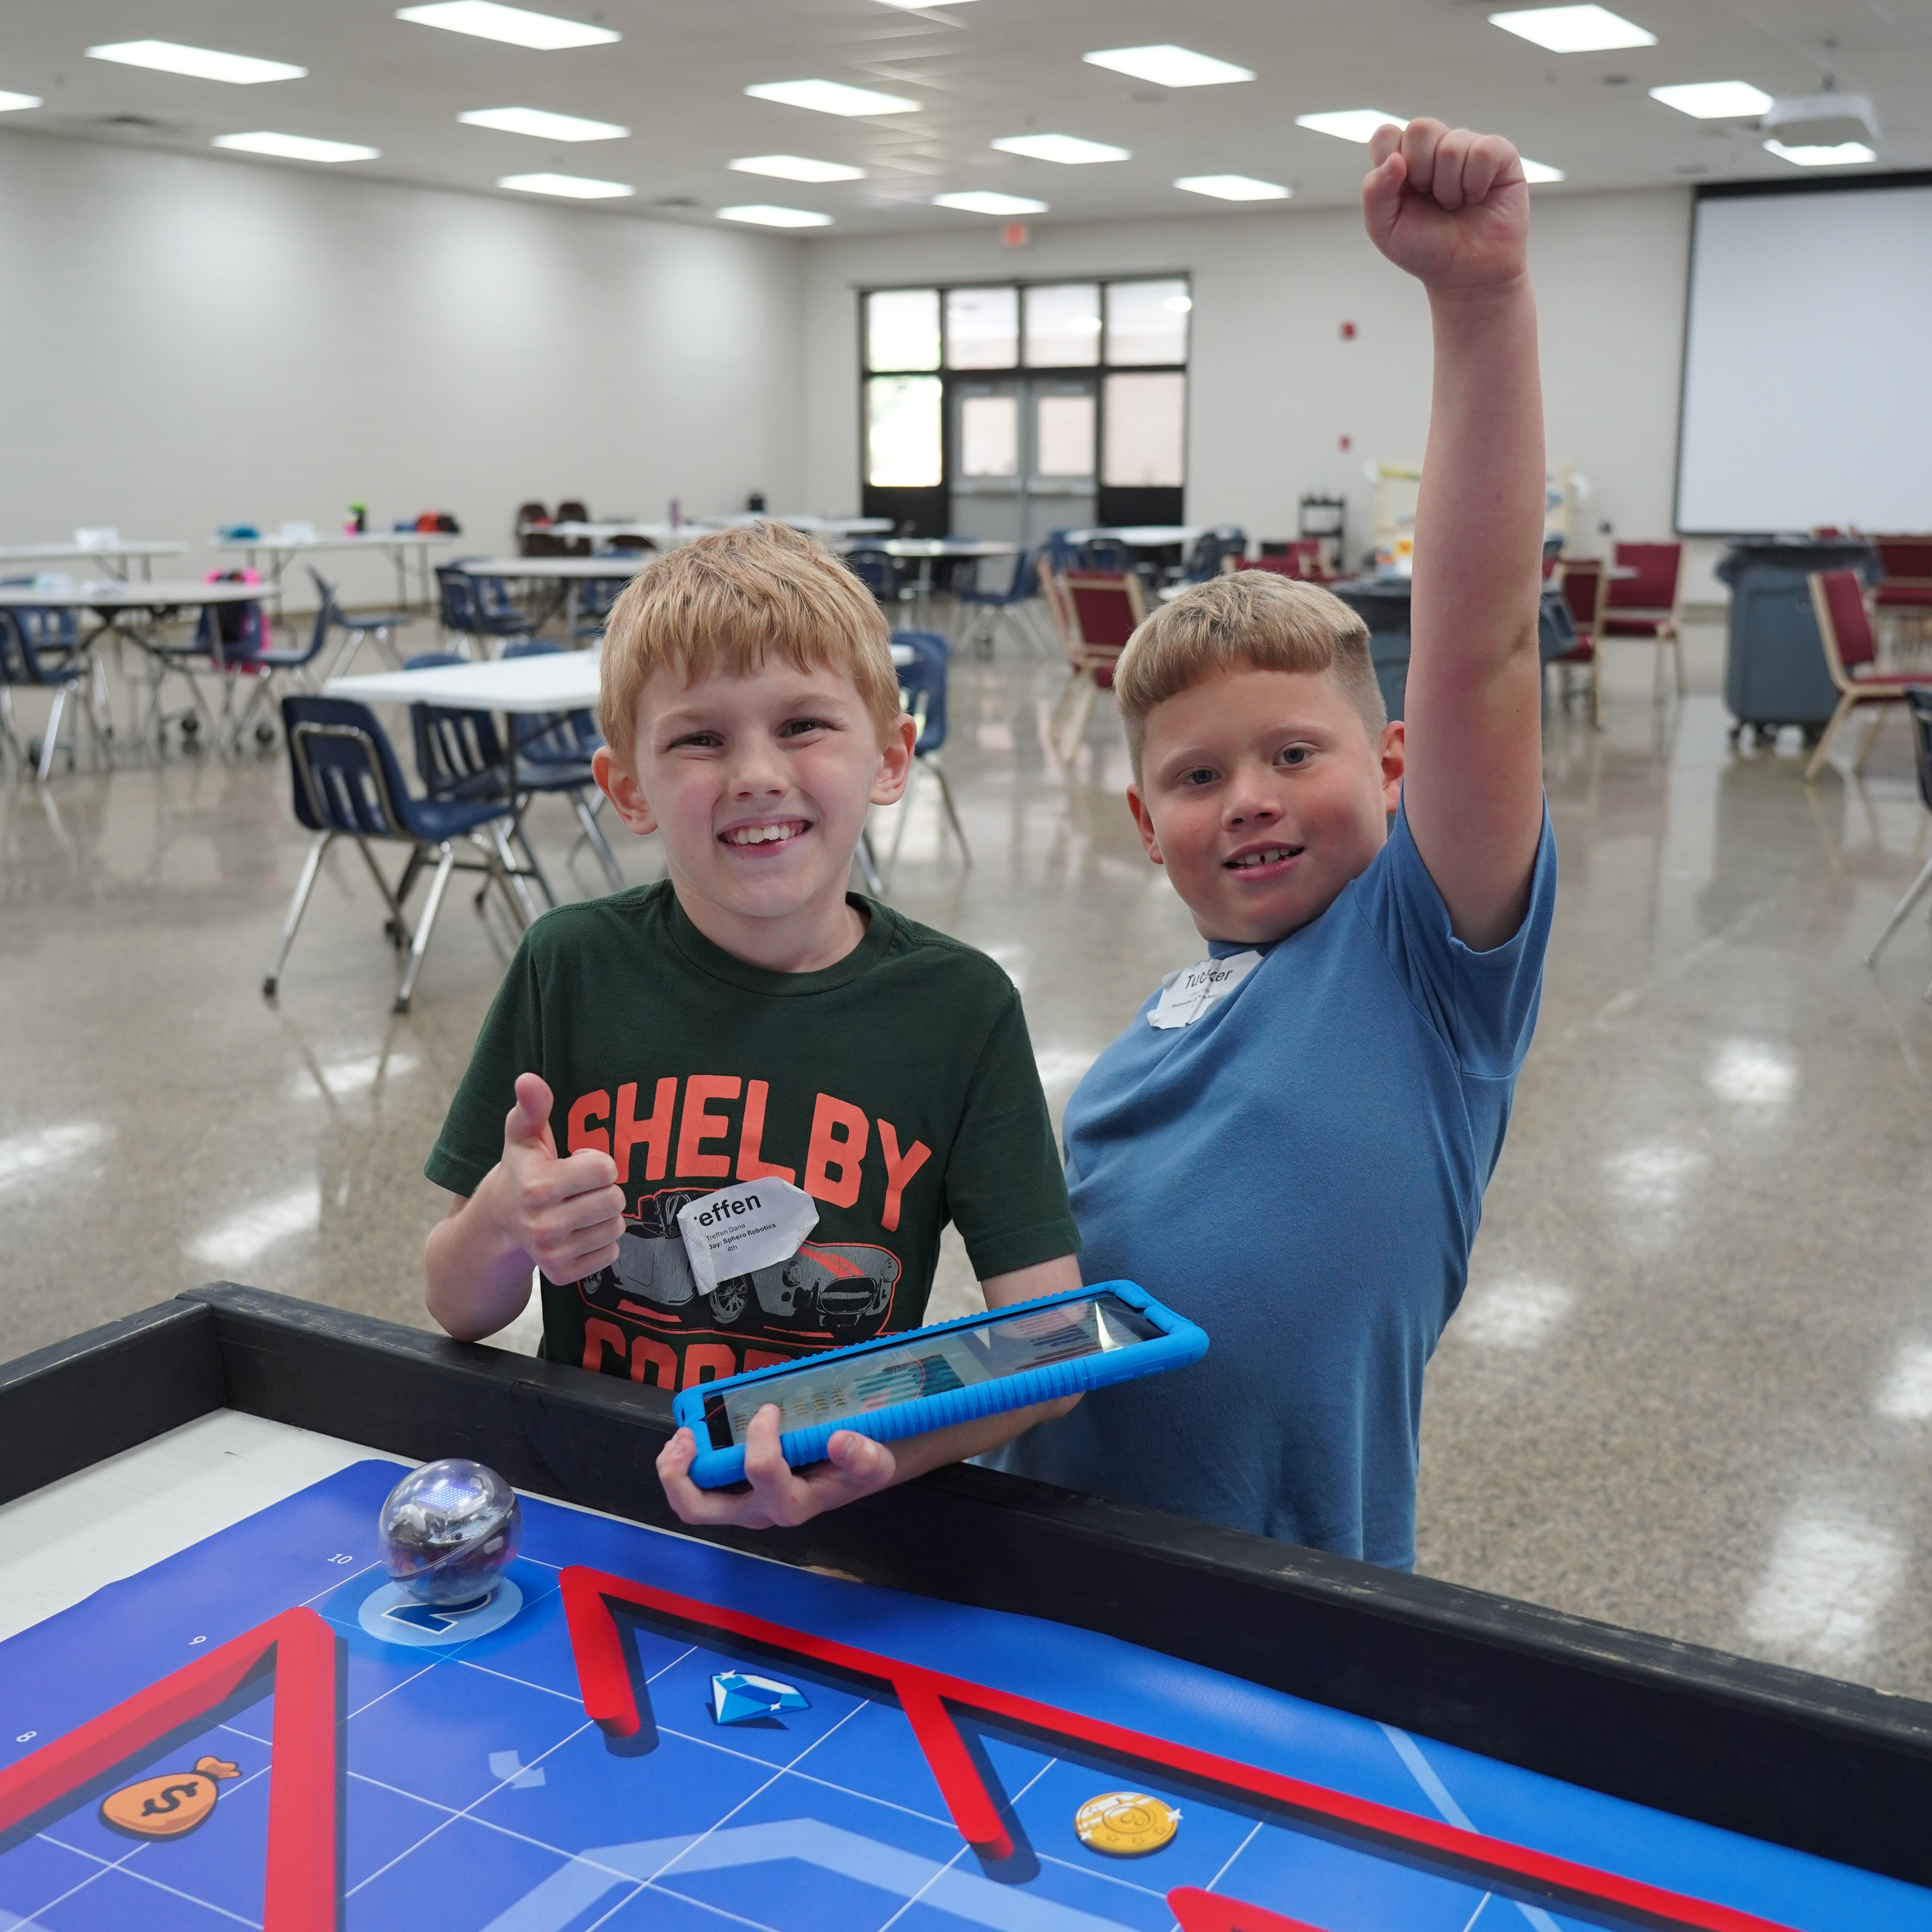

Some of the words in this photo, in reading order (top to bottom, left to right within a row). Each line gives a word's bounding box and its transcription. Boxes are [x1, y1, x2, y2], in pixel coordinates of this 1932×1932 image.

[568, 1075, 932, 1232] SHELBY
[694, 1194, 762, 1226] effen
[706, 1229, 728, 1241] Treffen
[728, 1223, 746, 1233] Dana
[723, 1233, 747, 1244] Sphero
[747, 1222, 776, 1236] Robotics
[327, 1553, 353, 1564] 10
[188, 1636, 206, 1645] 9
[16, 1731, 37, 1742] 8
